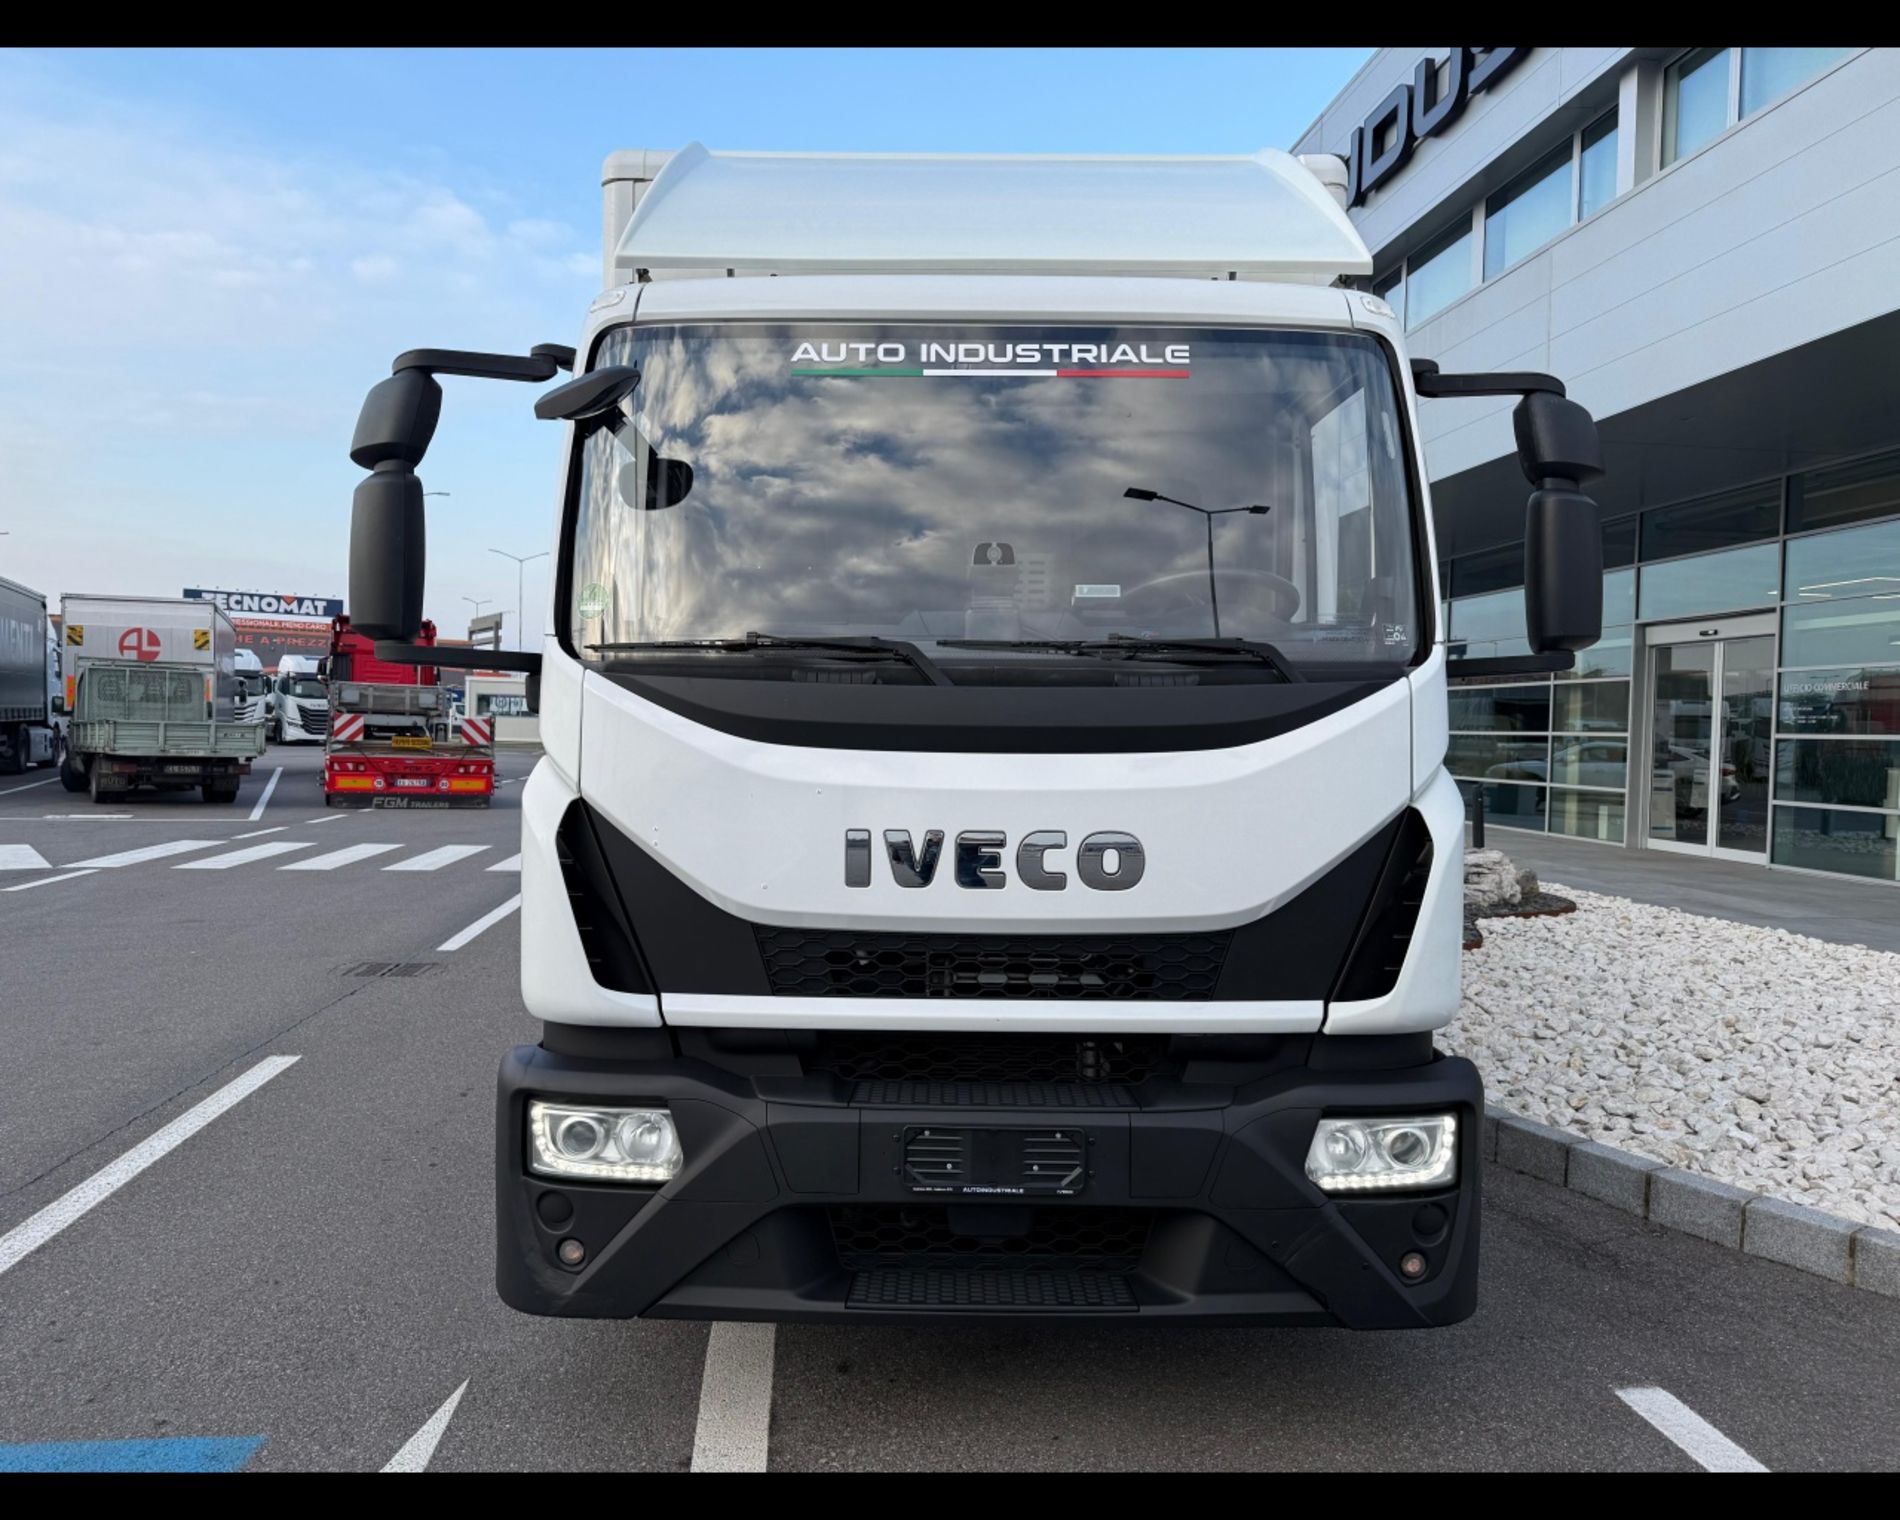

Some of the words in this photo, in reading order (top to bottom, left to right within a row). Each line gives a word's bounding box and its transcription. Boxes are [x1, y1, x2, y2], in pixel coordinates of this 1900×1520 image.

[790, 342, 905, 363] AUTO
[920, 342, 1190, 364] INDUSTRIALE
[372, 796, 409, 809] FGM
[844, 828, 1146, 891] IVECO
[962, 1186, 1024, 1194] AUTOINDUSTRIALE
